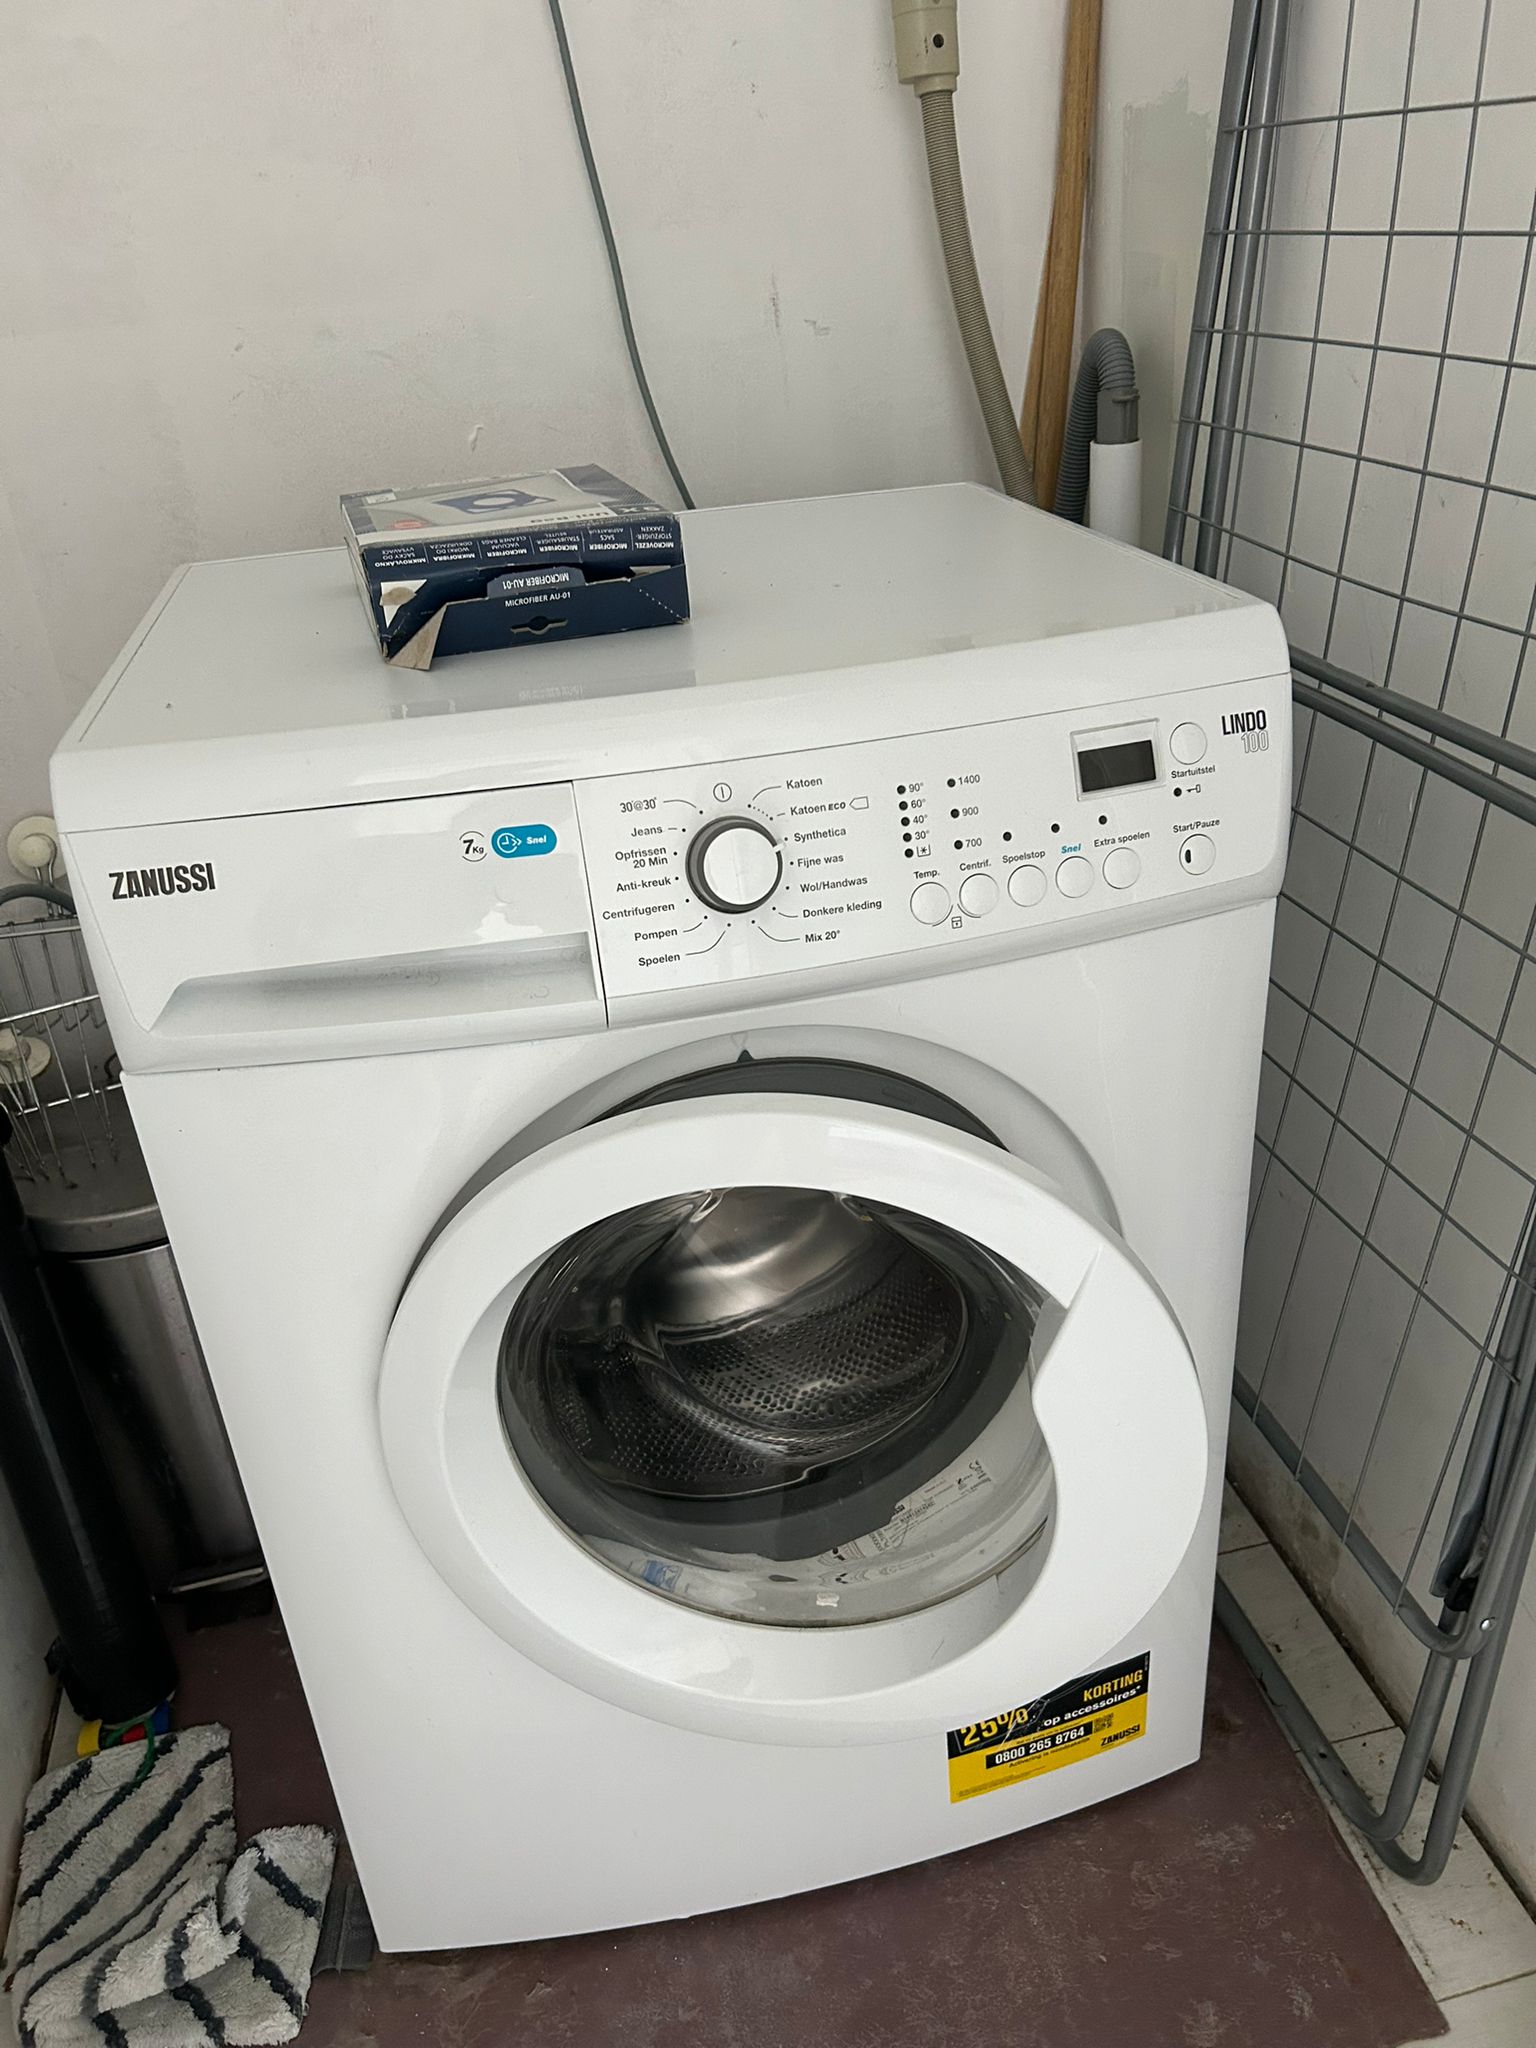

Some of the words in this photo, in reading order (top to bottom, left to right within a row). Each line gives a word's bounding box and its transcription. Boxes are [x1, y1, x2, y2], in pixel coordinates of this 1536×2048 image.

[498, 536, 526, 544] CLEANER
[599, 534, 615, 542] SACS
[491, 542, 520, 550] VACUUM
[539, 544, 578, 553] MICROFIBER
[589, 543, 628, 551] MICROFIBER
[635, 542, 674, 550] MICROVEZEL
[433, 553, 475, 562] MIKROFIBRA
[486, 549, 527, 558] MICROFIBER
[502, 578, 525, 590] AU-01
[526, 572, 570, 587] MICROFIBER
[505, 596, 548, 608] MICROFIBER
[549, 591, 571, 601] AU-01
[1221, 710, 1267, 735] LINDO
[1241, 729, 1269, 754] 100
[1171, 765, 1216, 779] Startuitstel
[786, 776, 823, 790] Katoen
[958, 775, 980, 786] 1400
[908, 783, 924, 793] 90°
[790, 802, 827, 816] Katoen
[910, 798, 926, 808] 60°
[962, 807, 979, 817] 900
[912, 814, 928, 825] 40°
[1173, 819, 1220, 833] Start/Pauze
[631, 824, 663, 838] Jeans
[794, 827, 846, 843] Synthetica
[914, 830, 930, 840] 30°
[526, 835, 547, 846] Snel
[965, 838, 982, 848] 700
[1094, 837, 1116, 848] Extra
[1118, 831, 1150, 844] spoelen
[615, 846, 667, 862] Opfrissen
[1061, 843, 1082, 854] Snel
[633, 858, 646, 869] 20
[648, 856, 668, 867] Min
[797, 855, 822, 868] Fijne
[824, 854, 844, 864] was
[1002, 850, 1046, 864] Spoelstop
[959, 860, 992, 871] Centrif.
[109, 862, 216, 900] ZANUSSI
[913, 869, 940, 880] Temp.
[616, 876, 671, 892] Anti-kreuk
[800, 876, 868, 893] Wol/Handwas
[602, 902, 675, 920] Centrifugeren
[802, 905, 846, 918] Donkere
[847, 900, 882, 913] kleding
[634, 928, 678, 942] Pompen
[805, 933, 823, 943] Mix
[825, 930, 841, 941] 20°
[638, 953, 681, 967] Spoelen
[1083, 1670, 1144, 1703] KORTING
[1043, 1717, 1061, 1728] op
[1101, 1724, 1141, 1747] ZANUSSI
[995, 1745, 1026, 1764] 0800
[1029, 1740, 1052, 1756] 265
[1055, 1727, 1085, 1745] 8764
